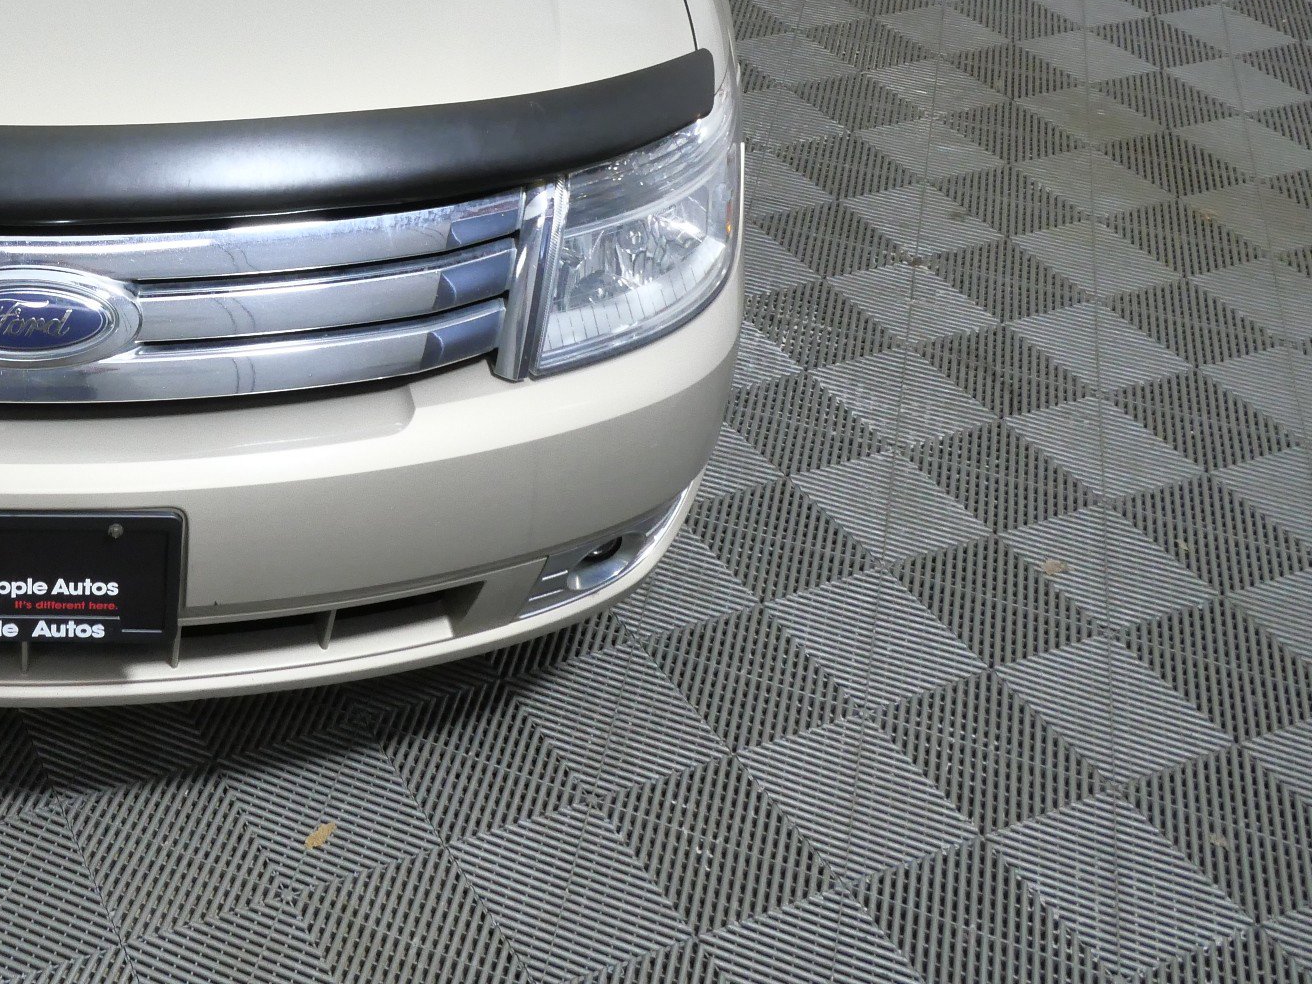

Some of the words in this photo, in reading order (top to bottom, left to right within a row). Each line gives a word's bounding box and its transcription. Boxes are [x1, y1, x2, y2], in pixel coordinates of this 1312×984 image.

[51, 578, 119, 596] Autos
[14, 600, 32, 610] It's
[35, 600, 86, 610] different
[88, 601, 118, 611] here.
[31, 620, 106, 639] Autos
